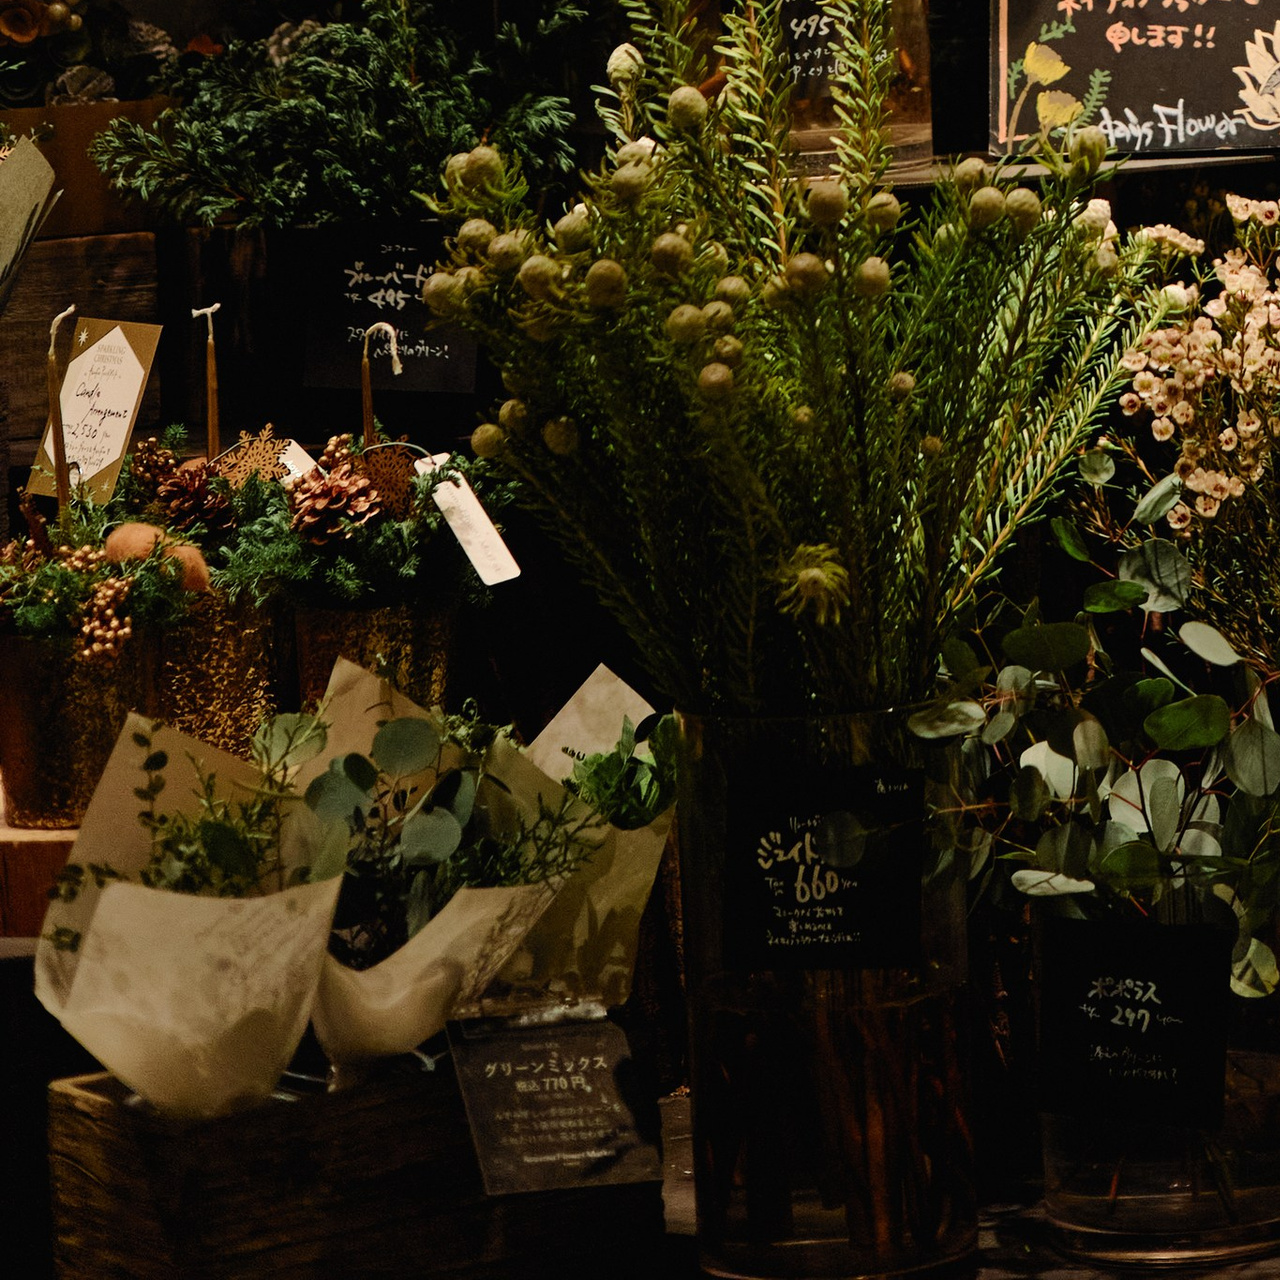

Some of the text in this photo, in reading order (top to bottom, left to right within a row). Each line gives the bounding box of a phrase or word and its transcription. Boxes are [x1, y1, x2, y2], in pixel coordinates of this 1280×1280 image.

[789, 14, 834, 40] 495
[1153, 98, 1246, 147] Flower
[367, 288, 411, 311] 495
[794, 865, 839, 903] 660
[1110, 1005, 1151, 1033] 297
[485, 1056, 608, 1078] グリーンミックス
